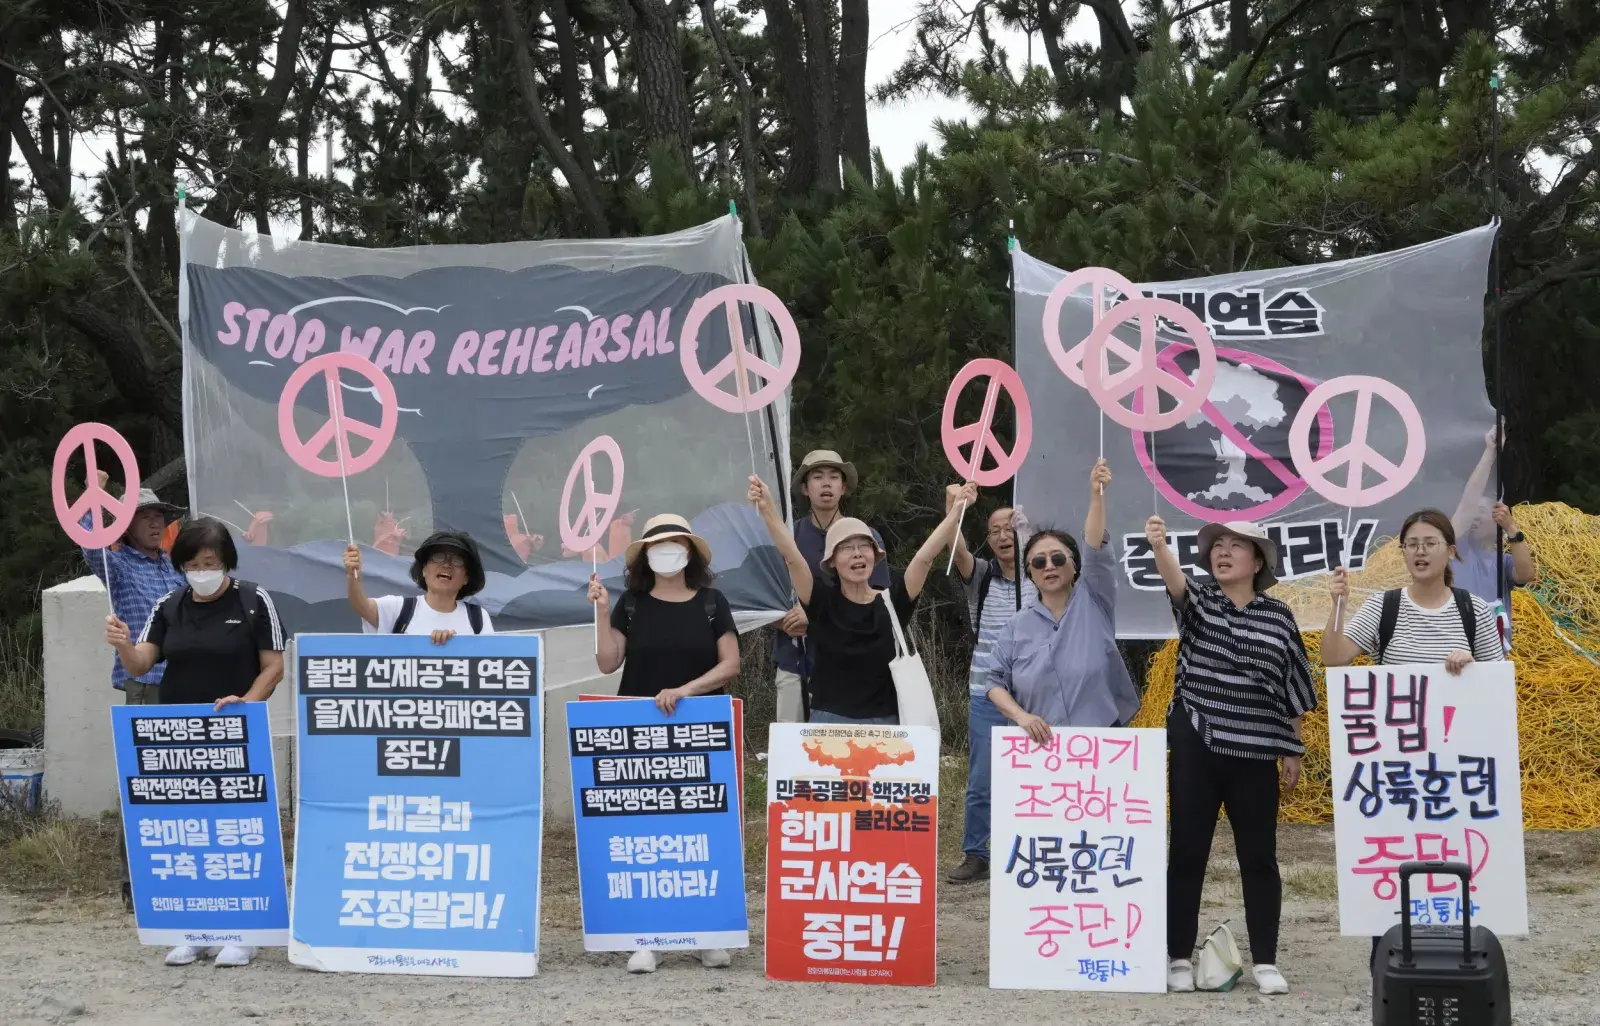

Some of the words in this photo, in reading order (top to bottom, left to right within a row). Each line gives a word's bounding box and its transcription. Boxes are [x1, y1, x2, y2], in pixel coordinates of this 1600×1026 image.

[1111, 288, 1324, 336] 연습
[217, 301, 326, 363] STOP
[340, 325, 436, 374] WAR
[446, 306, 675, 376] REHEARSAL
[306, 658, 357, 688] 불법
[364, 658, 470, 689] 선제공격
[477, 659, 532, 690] 연습
[135, 718, 205, 741] 핵전쟁은
[208, 716, 244, 740] 공멸
[313, 699, 525, 730] 을지자유방패연습
[575, 727, 629, 751] 민족의
[632, 726, 669, 749] 공멸
[673, 724, 727, 748] 부르는
[828, 729, 853, 738] 전쟁연습
[854, 730, 867, 738] 중단
[142, 747, 245, 770] 을지자유방패
[384, 739, 451, 770] 중단!
[1001, 733, 1139, 772] 전쟁위기
[598, 755, 706, 782] 을지자유방패
[131, 777, 217, 800] 핵전쟁연습
[220, 775, 264, 799] 중단!
[585, 787, 676, 812] 핵전쟁연습
[679, 784, 725, 809] 중단!
[776, 779, 867, 803] 민족공멸의
[872, 781, 931, 805] 핵전쟁
[1014, 774, 1152, 824] 조장하는
[1343, 752, 1499, 822] 상륙훈련
[368, 794, 473, 833] 대결과
[854, 809, 930, 832] 불러오는
[138, 818, 210, 847] 한미일
[215, 817, 265, 846] 동맹
[780, 809, 850, 852] 한미
[343, 842, 491, 881] 전쟁위기
[608, 833, 710, 865] 확장억제
[1005, 830, 1143, 893] 상륙훈련
[151, 852, 198, 881] 구축
[203, 852, 262, 880] 중단!
[780, 859, 923, 904] 군사연습
[607, 869, 719, 899] 폐기하라!
[151, 897, 185, 911] 한미일
[186, 897, 240, 911] 프레임워크
[241, 896, 269, 911] 폐기!
[339, 889, 506, 930] 조장말라!
[802, 912, 906, 962] 중단!
[1024, 902, 1142, 958] 중단!
